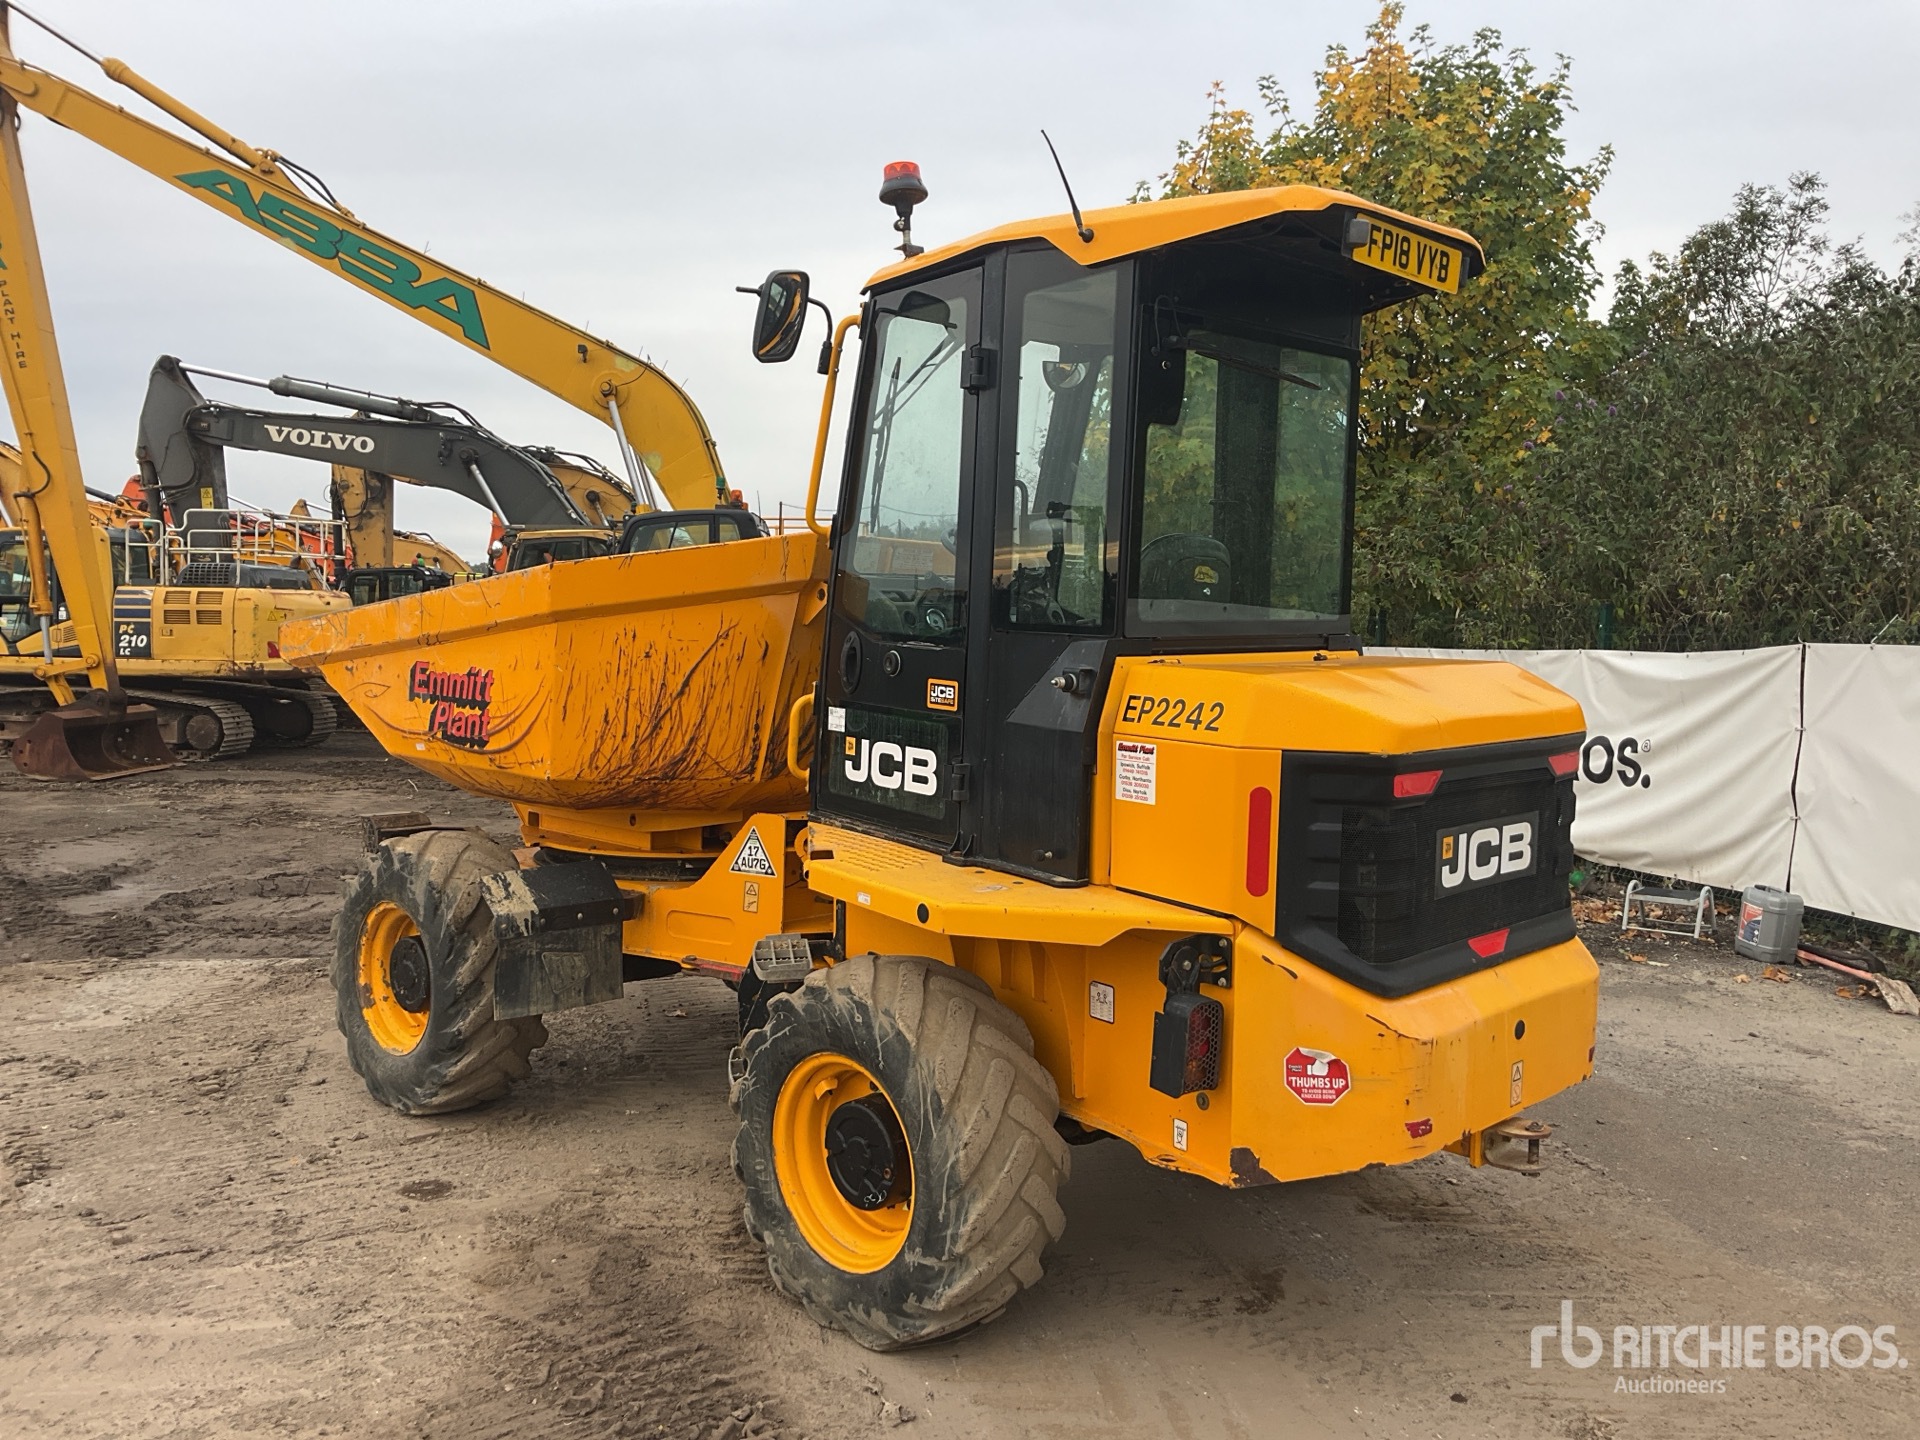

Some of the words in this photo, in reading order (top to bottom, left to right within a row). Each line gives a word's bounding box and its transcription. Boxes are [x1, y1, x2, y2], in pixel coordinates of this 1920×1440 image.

[173, 169, 491, 351] ABBA
[1367, 223, 1411, 270] FP18
[1416, 241, 1450, 283] VYB
[11, 332, 27, 369] HIRE
[264, 424, 375, 453] VOLVO
[119, 624, 134, 634] PC
[119, 635, 147, 648] 210
[410, 661, 494, 706] Emmitt
[931, 685, 954, 698] JCB
[430, 700, 491, 746] Plant
[1122, 694, 1224, 732] EP2242
[845, 738, 938, 796] JCB
[741, 857, 767, 870] AU7G
[748, 845, 760, 857] 17
[1441, 821, 1532, 888] JCB
